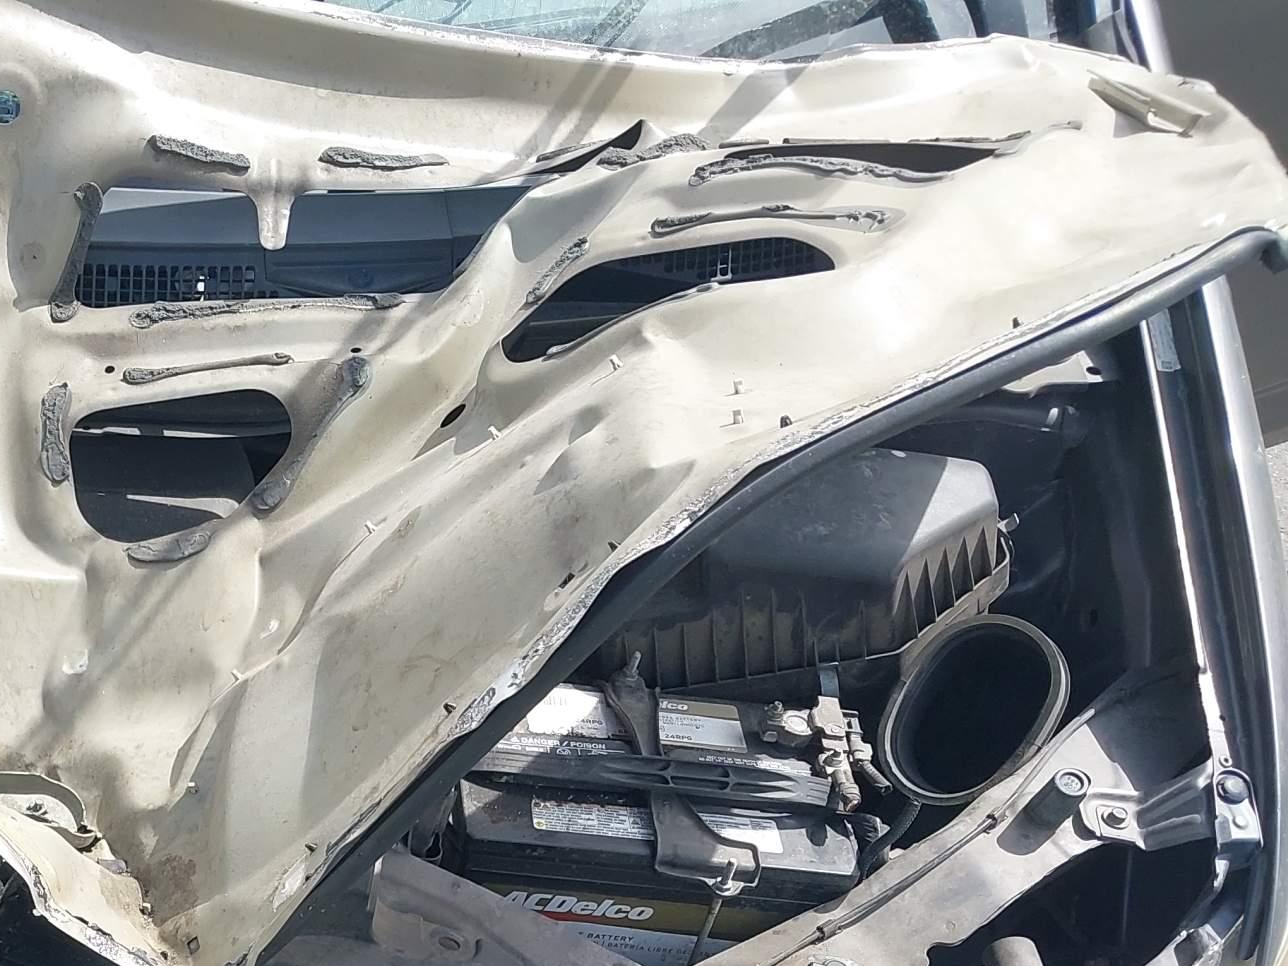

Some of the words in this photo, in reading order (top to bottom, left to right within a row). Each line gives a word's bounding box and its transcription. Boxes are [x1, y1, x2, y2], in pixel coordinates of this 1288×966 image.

[520, 737, 560, 746] DANGER
[570, 741, 607, 750] POISON
[504, 890, 654, 921] ACDelco
[586, 932, 635, 943] BATTERY
